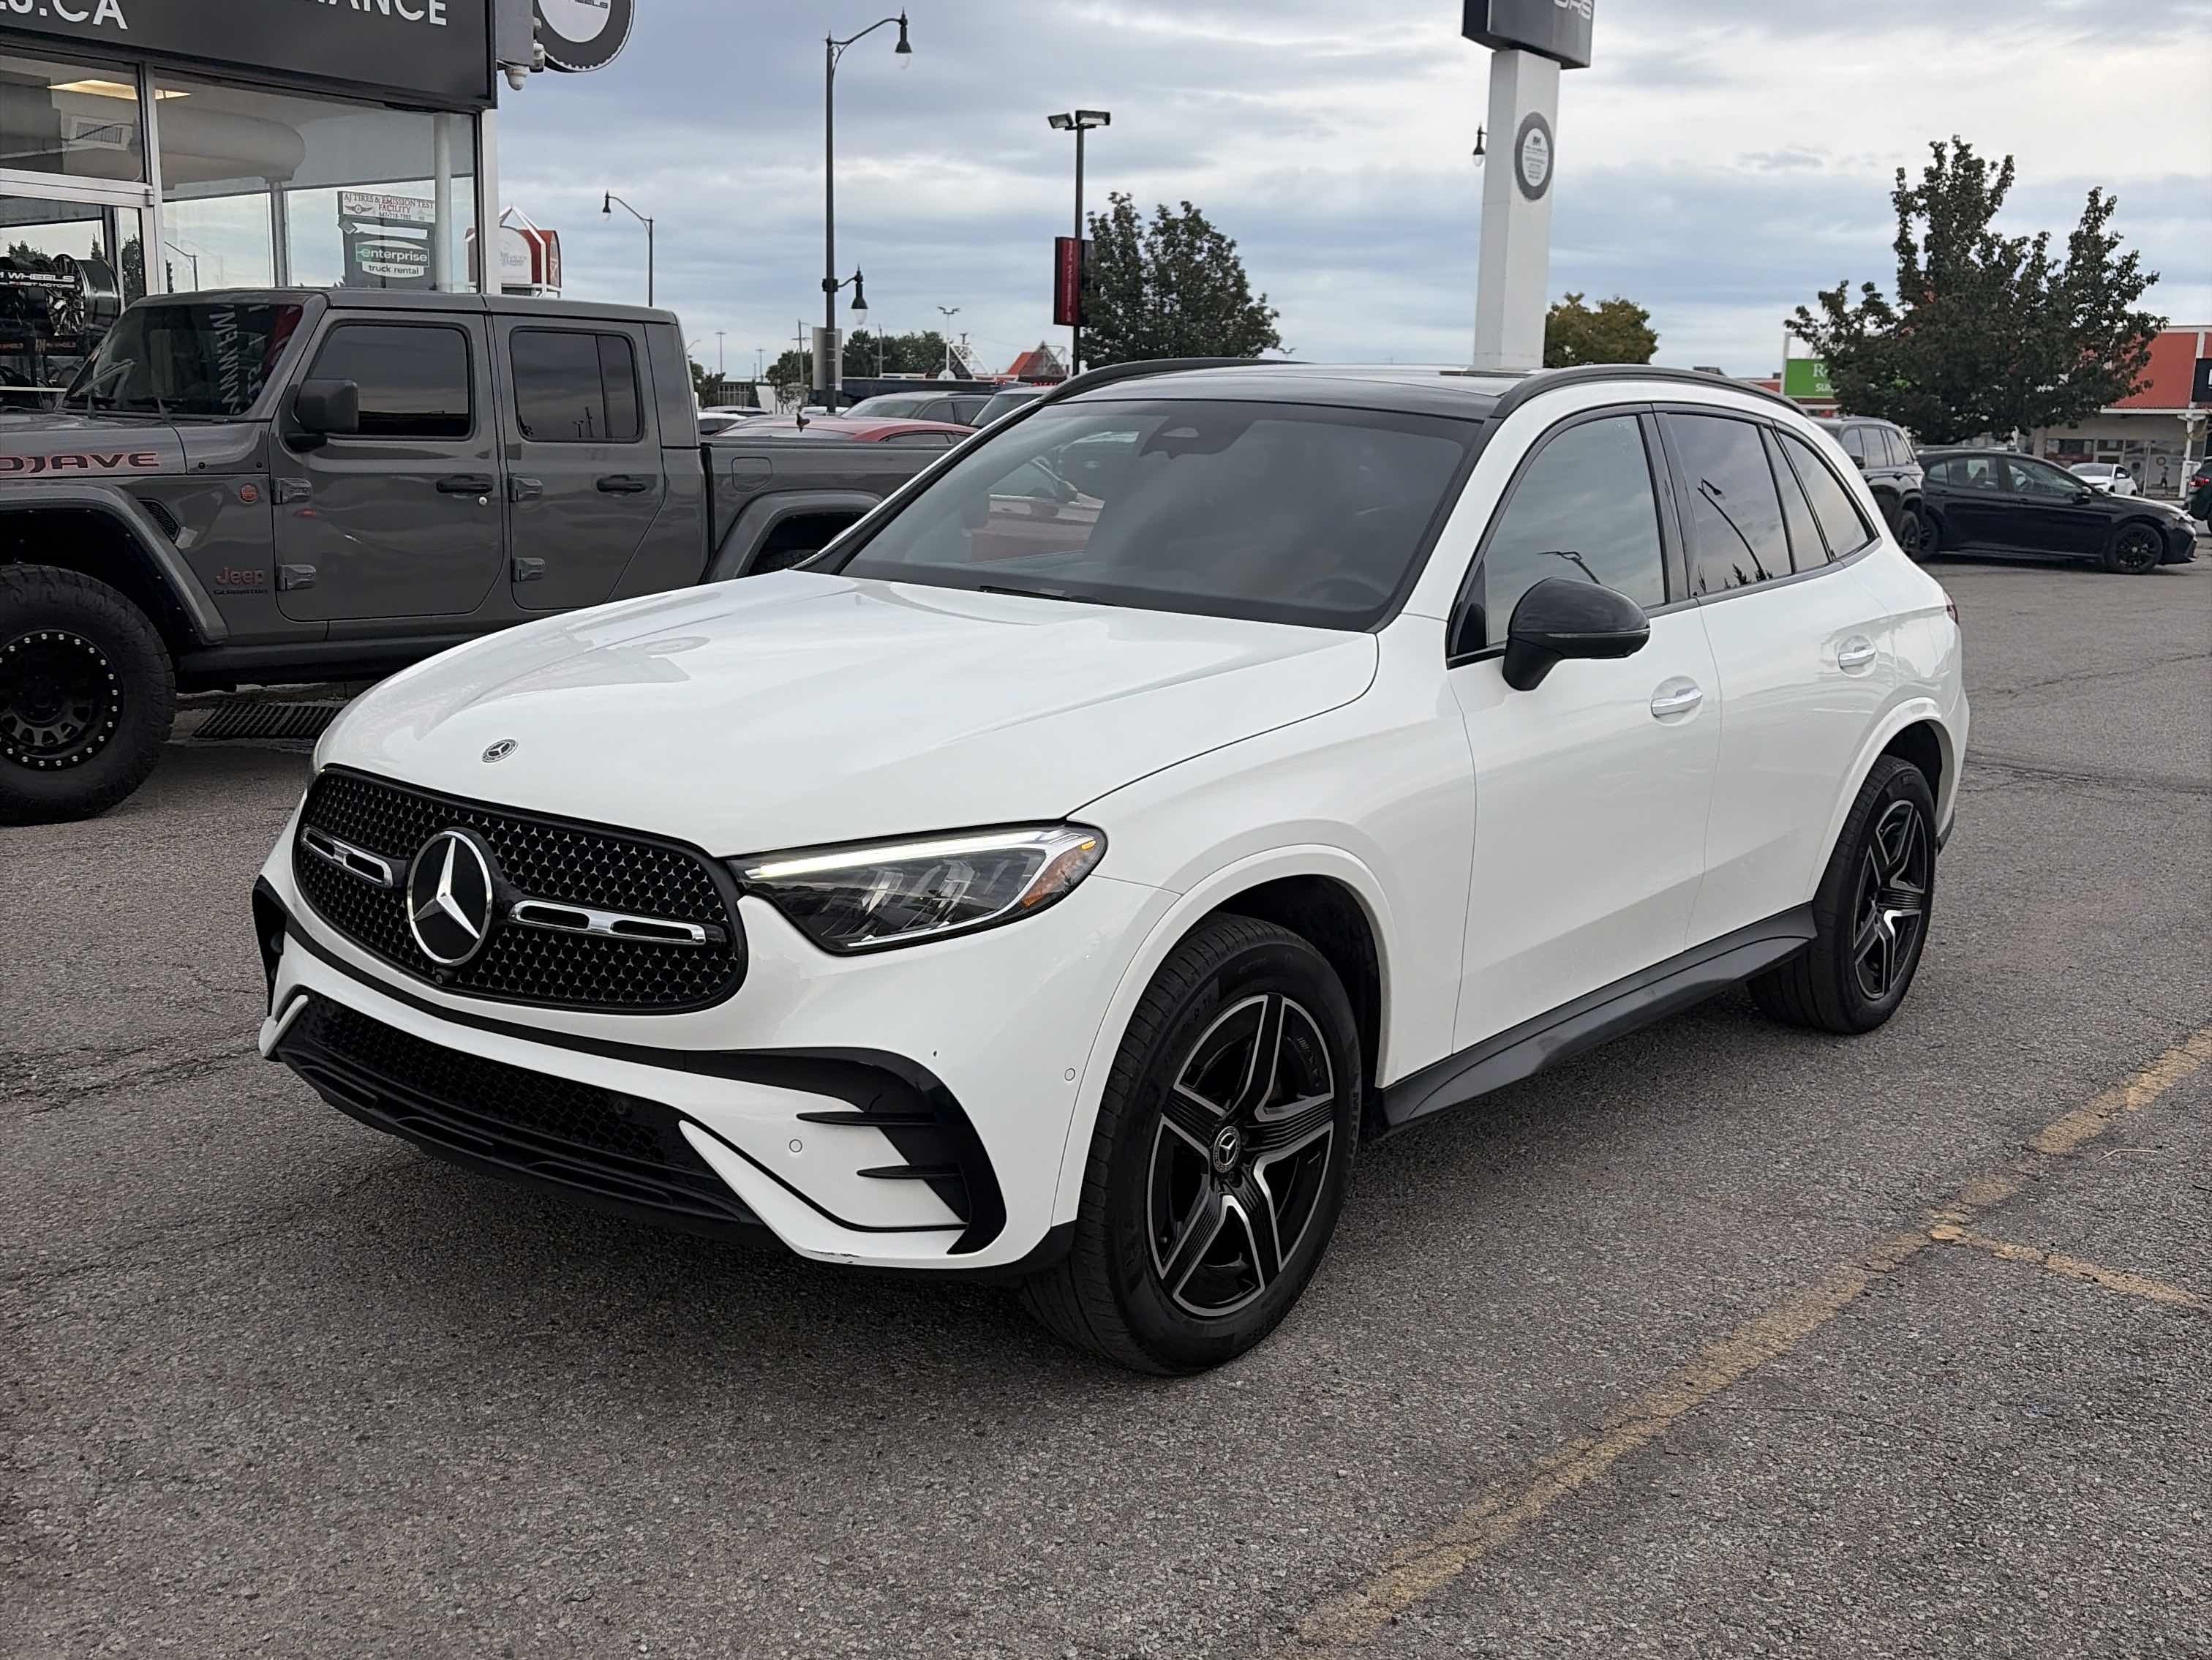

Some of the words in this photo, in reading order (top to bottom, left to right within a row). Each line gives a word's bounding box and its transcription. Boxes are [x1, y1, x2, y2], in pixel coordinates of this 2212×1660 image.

[353, 194, 374, 203] TIRES
[382, 195, 416, 208] EMISSION
[416, 200, 434, 209] TEST
[378, 203, 411, 214] FACILITY
[358, 247, 428, 263] enterprise
[368, 264, 391, 274] truck
[394, 266, 419, 275] rental
[7, 271, 75, 282] WHEELS
[216, 567, 264, 586] Jeep
